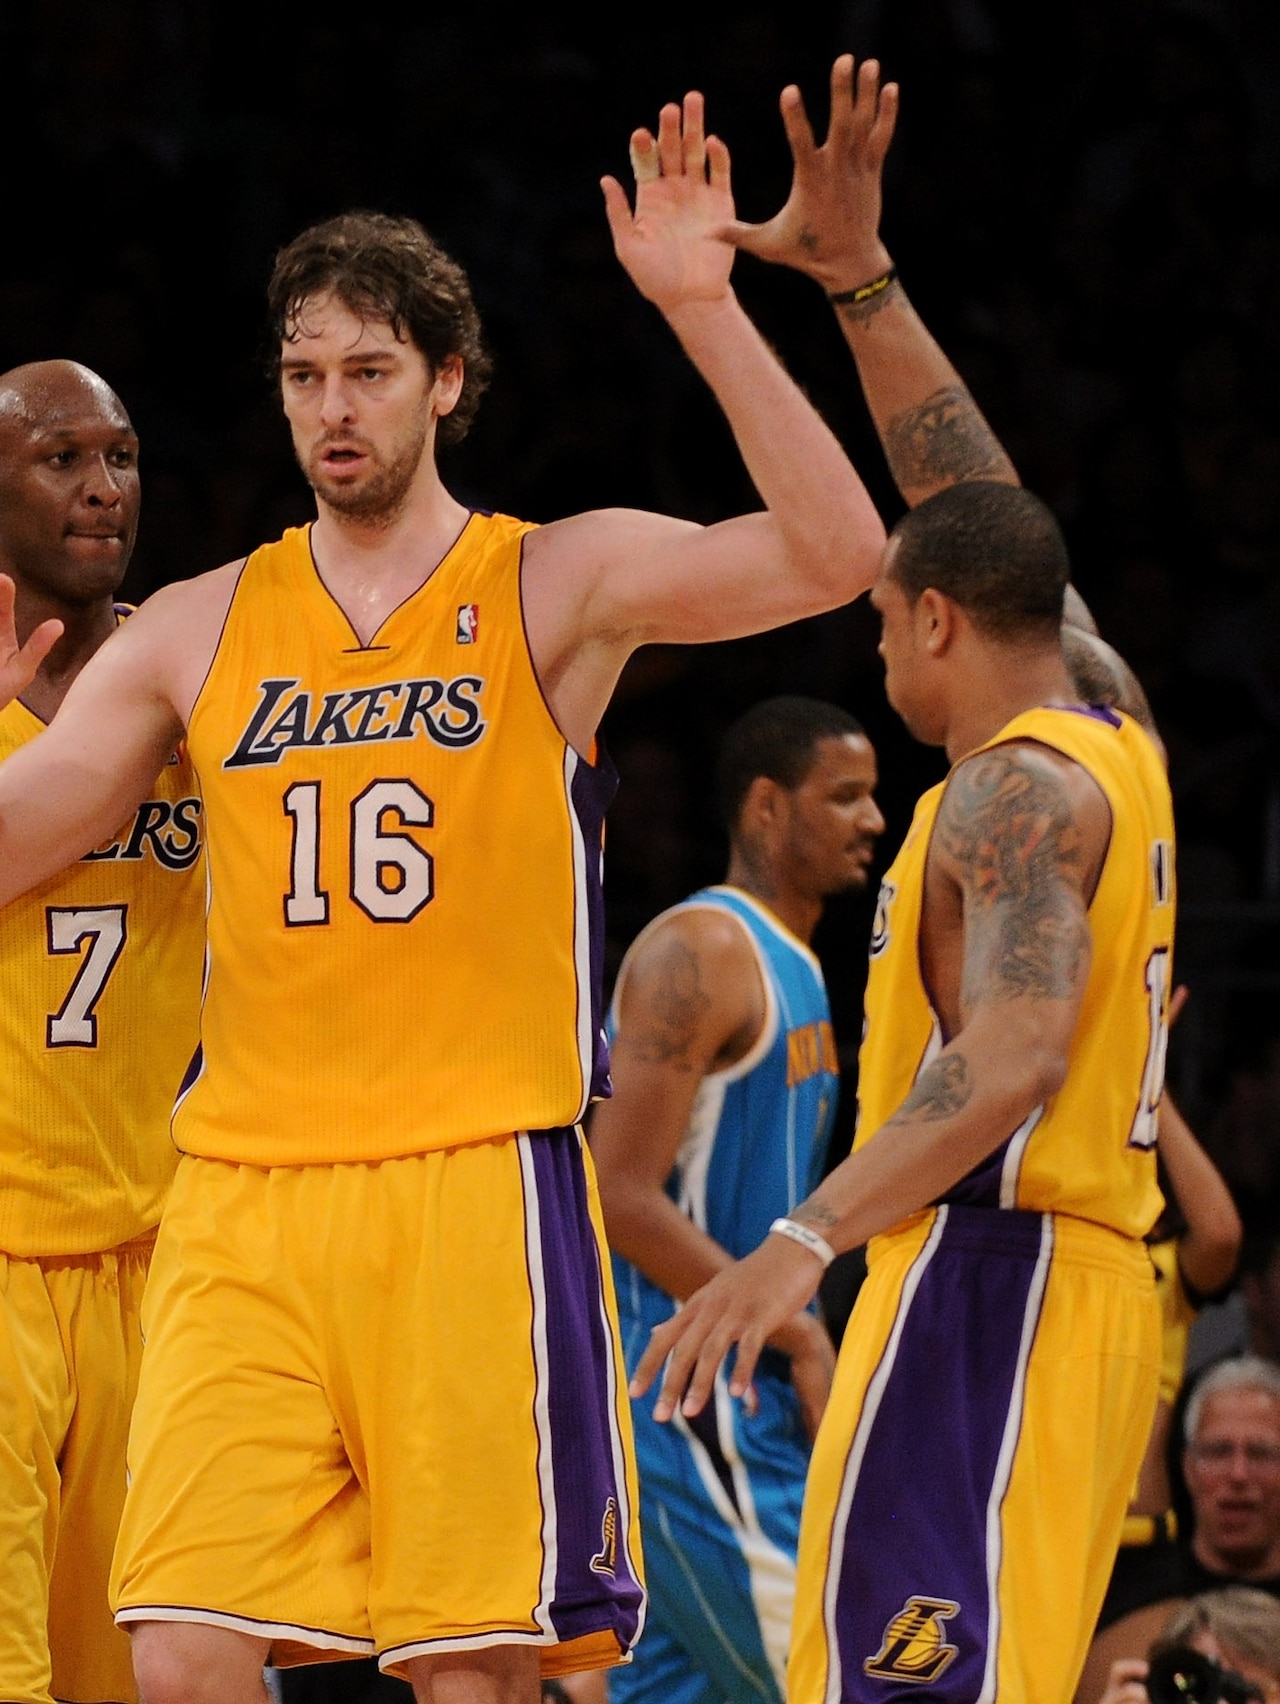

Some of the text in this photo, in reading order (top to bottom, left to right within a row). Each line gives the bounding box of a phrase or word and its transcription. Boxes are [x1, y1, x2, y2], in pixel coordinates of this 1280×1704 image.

[222, 676, 489, 770] LAKERS
[282, 778, 435, 928] 16
[45, 903, 128, 1049] 7
